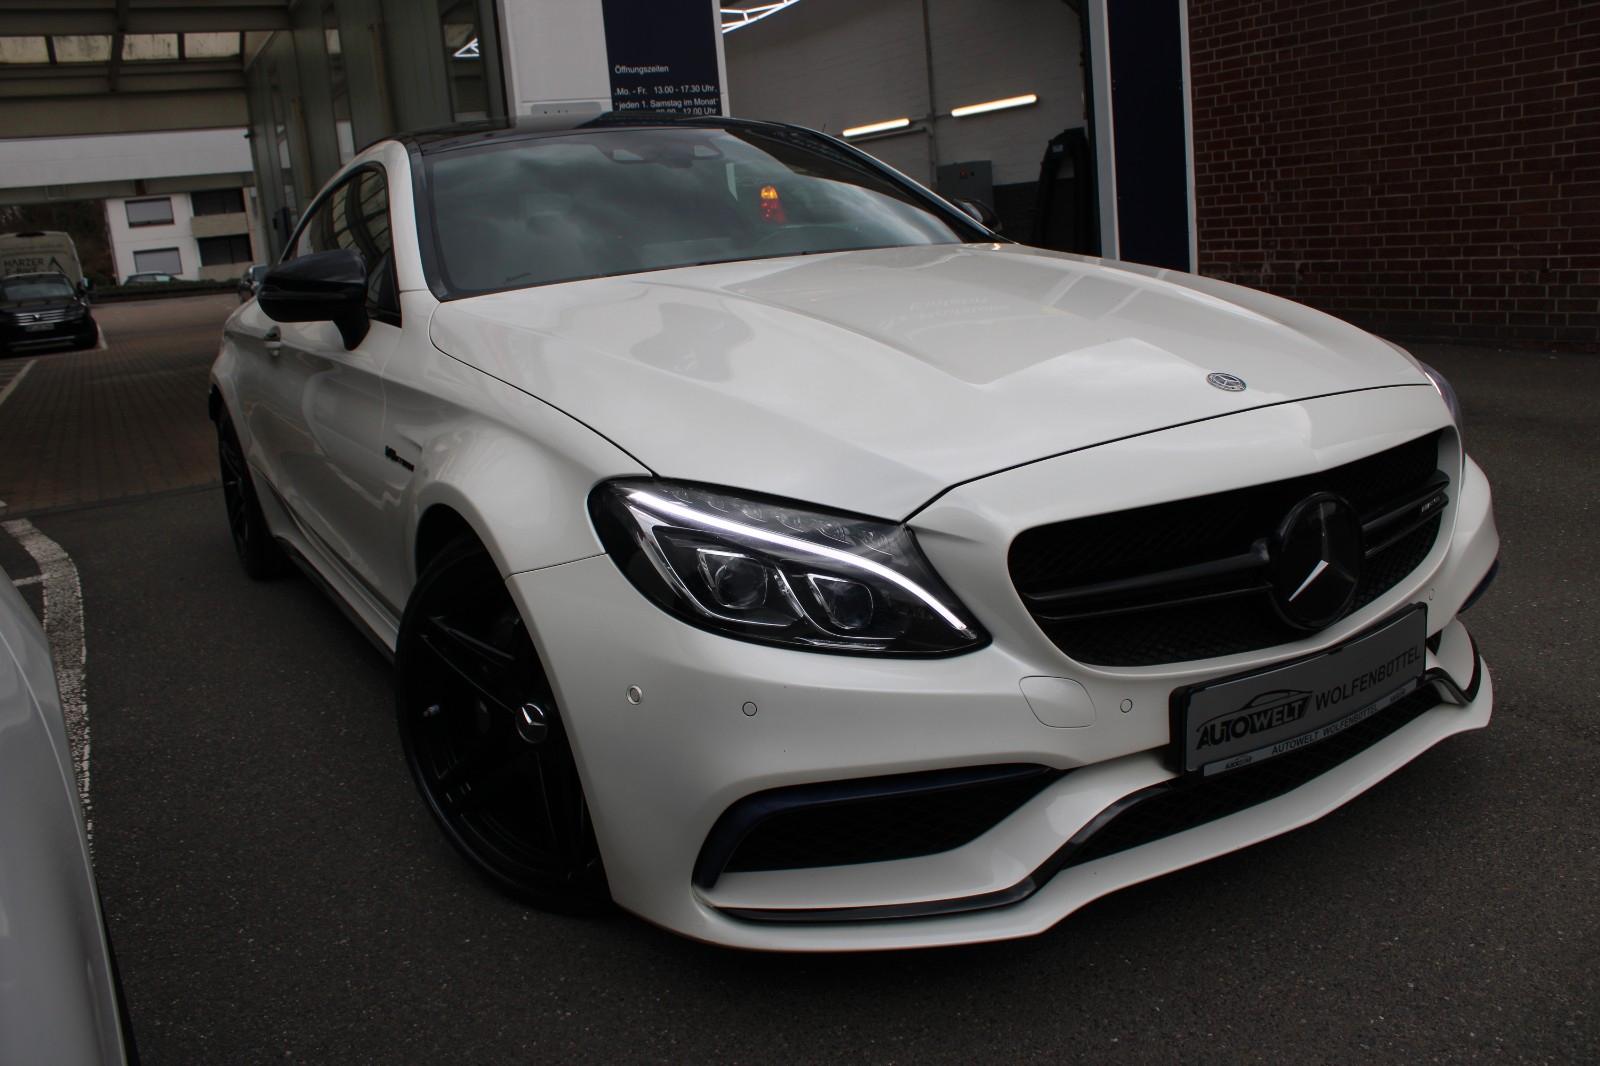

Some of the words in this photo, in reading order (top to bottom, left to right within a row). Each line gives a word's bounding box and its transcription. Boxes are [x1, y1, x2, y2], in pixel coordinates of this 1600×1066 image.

[615, 65, 669, 75] Öffnungszeiten
[637, 86, 647, 95] Fr.
[654, 86, 674, 94] 13.00
[619, 102, 639, 110] jeden
[650, 99, 682, 108] Samstag
[684, 98, 692, 106] im
[694, 97, 716, 105] Monat
[683, 107, 702, 115] 1200
[1196, 696, 1310, 750] AUTOWELT
[1272, 731, 1318, 755] AUTOWELT
